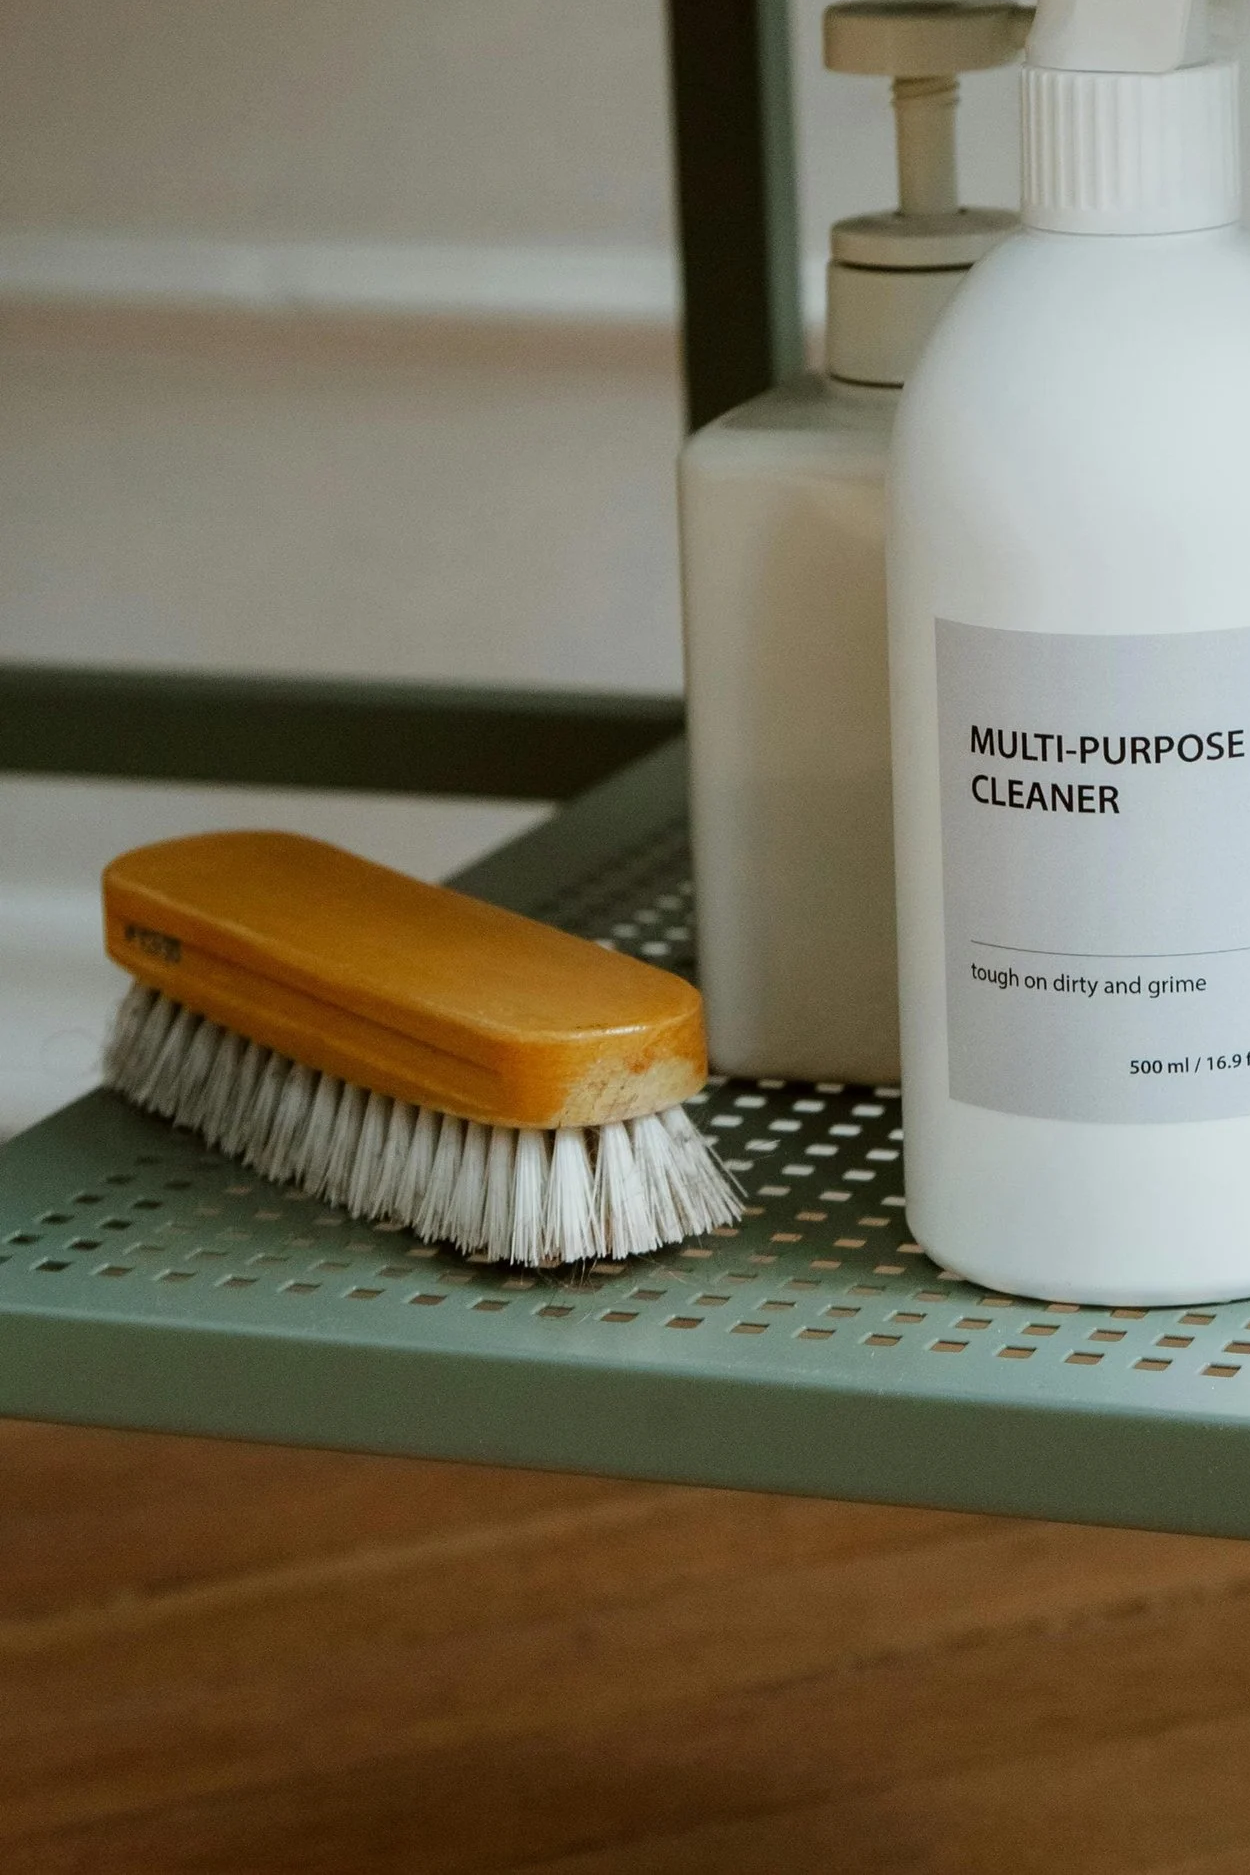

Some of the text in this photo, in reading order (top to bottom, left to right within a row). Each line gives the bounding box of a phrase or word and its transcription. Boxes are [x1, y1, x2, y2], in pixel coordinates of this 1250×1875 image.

[971, 725, 1244, 765] MULTI-PURPOSE
[972, 775, 1119, 814] CLEANER
[971, 963, 1206, 998] tough on dirty and grime
[1130, 1060, 1163, 1074] 500
[1168, 1057, 1189, 1073] ml
[1194, 1057, 1201, 1073] /
[1207, 1054, 1242, 1070] 16.9
